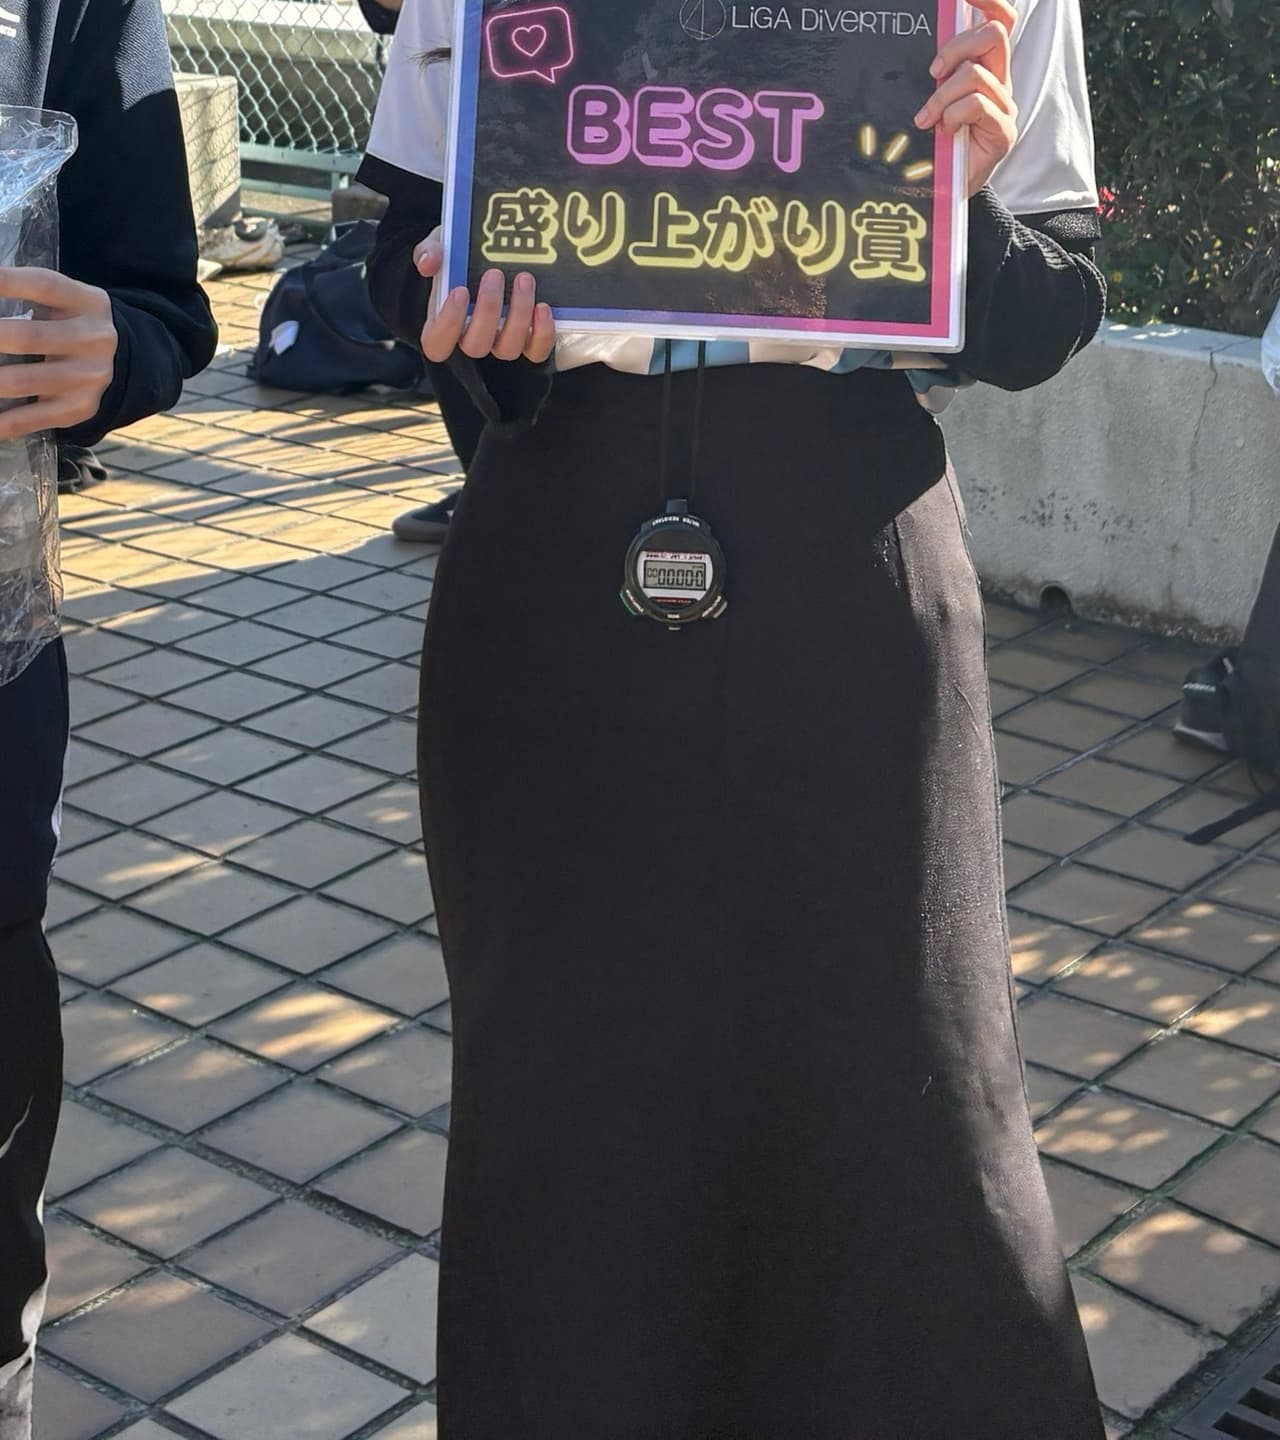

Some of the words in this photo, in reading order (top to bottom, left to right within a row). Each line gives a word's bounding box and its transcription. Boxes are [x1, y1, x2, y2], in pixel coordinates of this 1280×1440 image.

[566, 84, 824, 173] BEST
[481, 187, 927, 282] 盛り上がり賞
